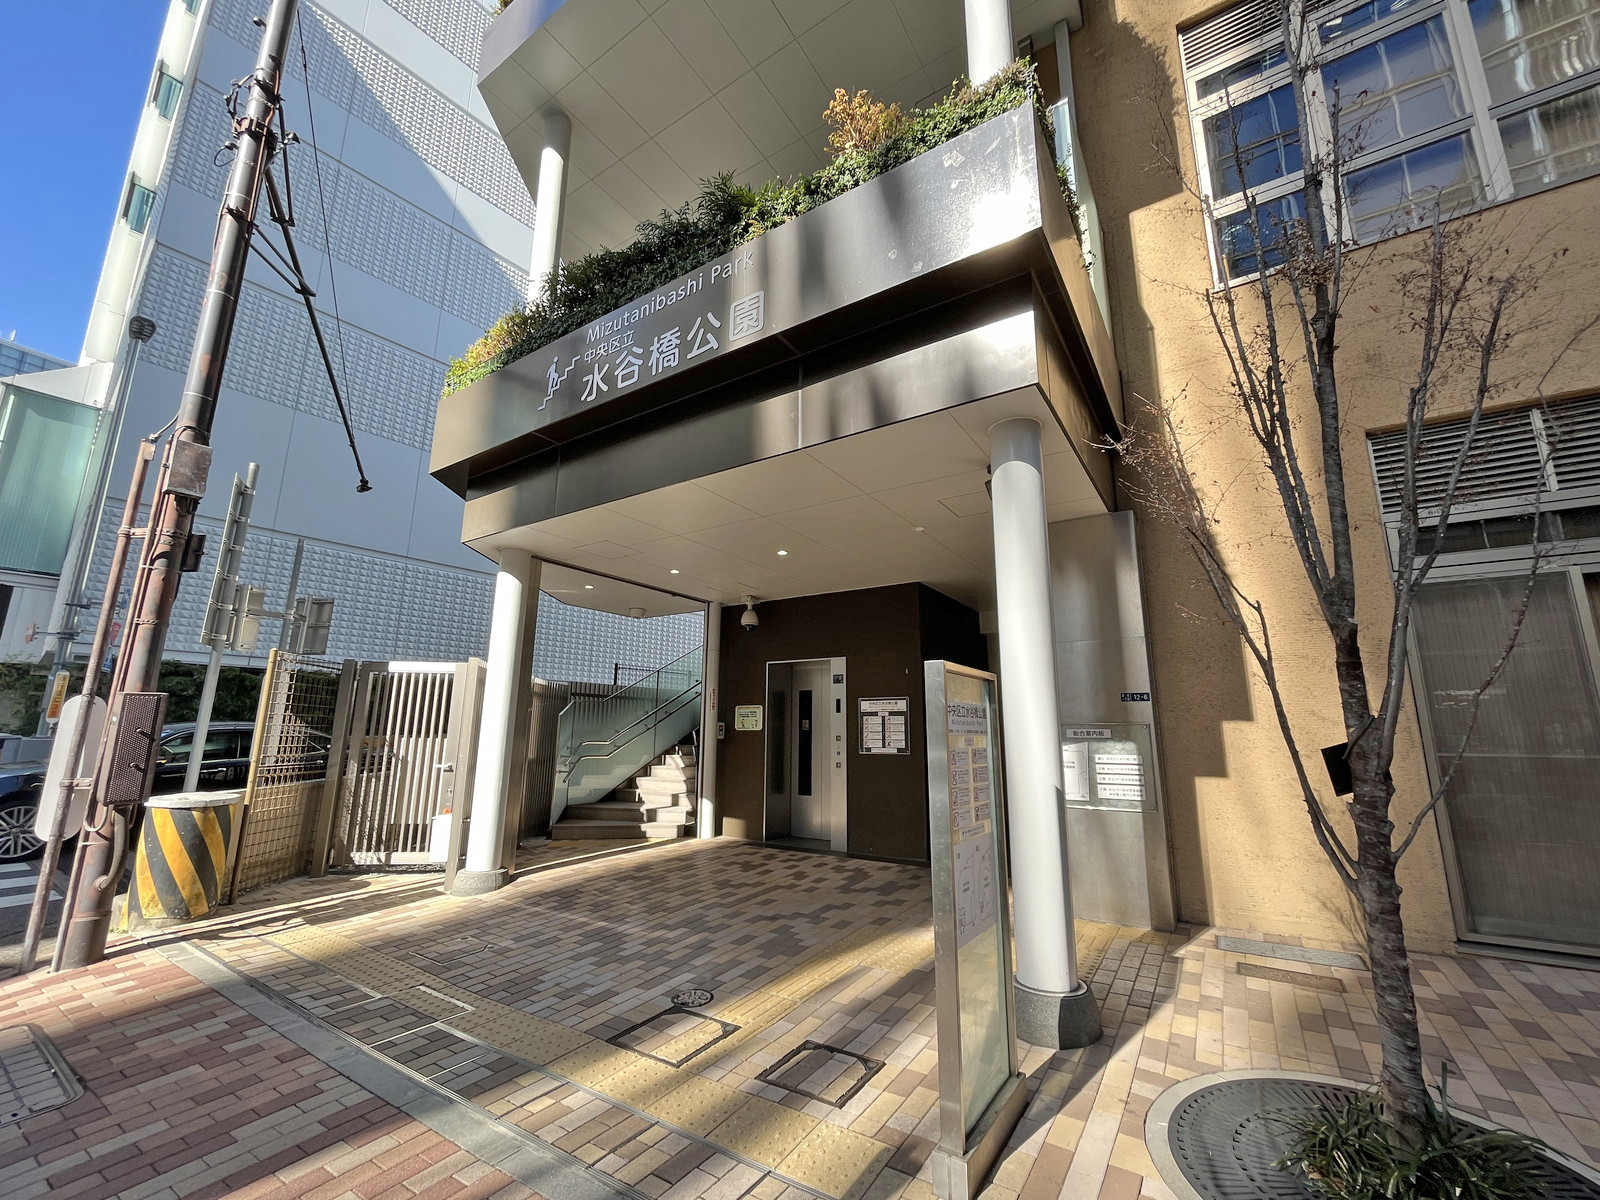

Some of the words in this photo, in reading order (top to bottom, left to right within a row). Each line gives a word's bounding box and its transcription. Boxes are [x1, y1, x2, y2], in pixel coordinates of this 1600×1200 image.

[585, 272, 704, 345] Mizutanibashi
[711, 251, 754, 284] Park
[580, 290, 765, 403] 水谷橋公園
[584, 330, 635, 364] 中央区立
